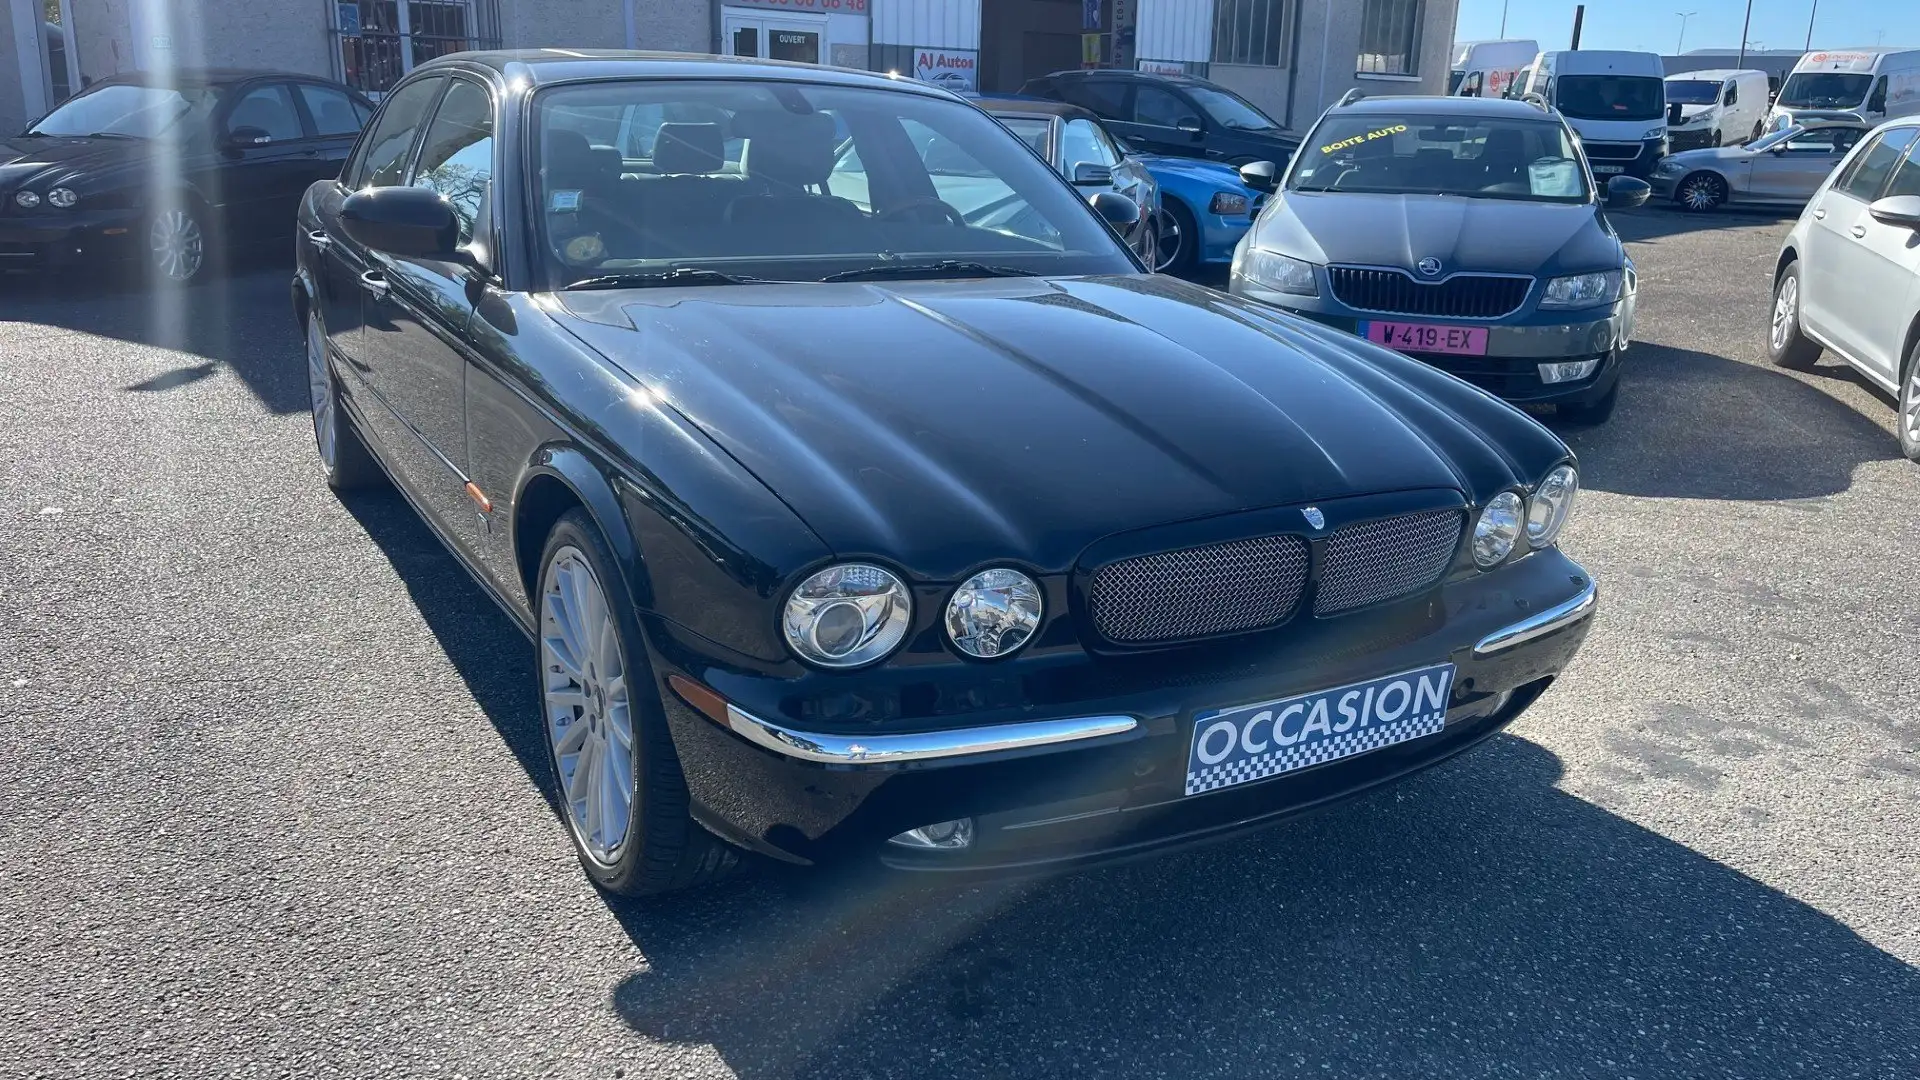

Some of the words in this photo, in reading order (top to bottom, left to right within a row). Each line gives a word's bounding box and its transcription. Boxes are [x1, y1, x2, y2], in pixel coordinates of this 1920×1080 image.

[779, 34, 806, 44] OUVERT
[936, 53, 974, 69] Autos
[1320, 135, 1366, 154] BOITE
[1367, 124, 1407, 141] AUTO
[1383, 324, 1472, 349] W-419-EX
[1197, 670, 1449, 765] OCCASION
